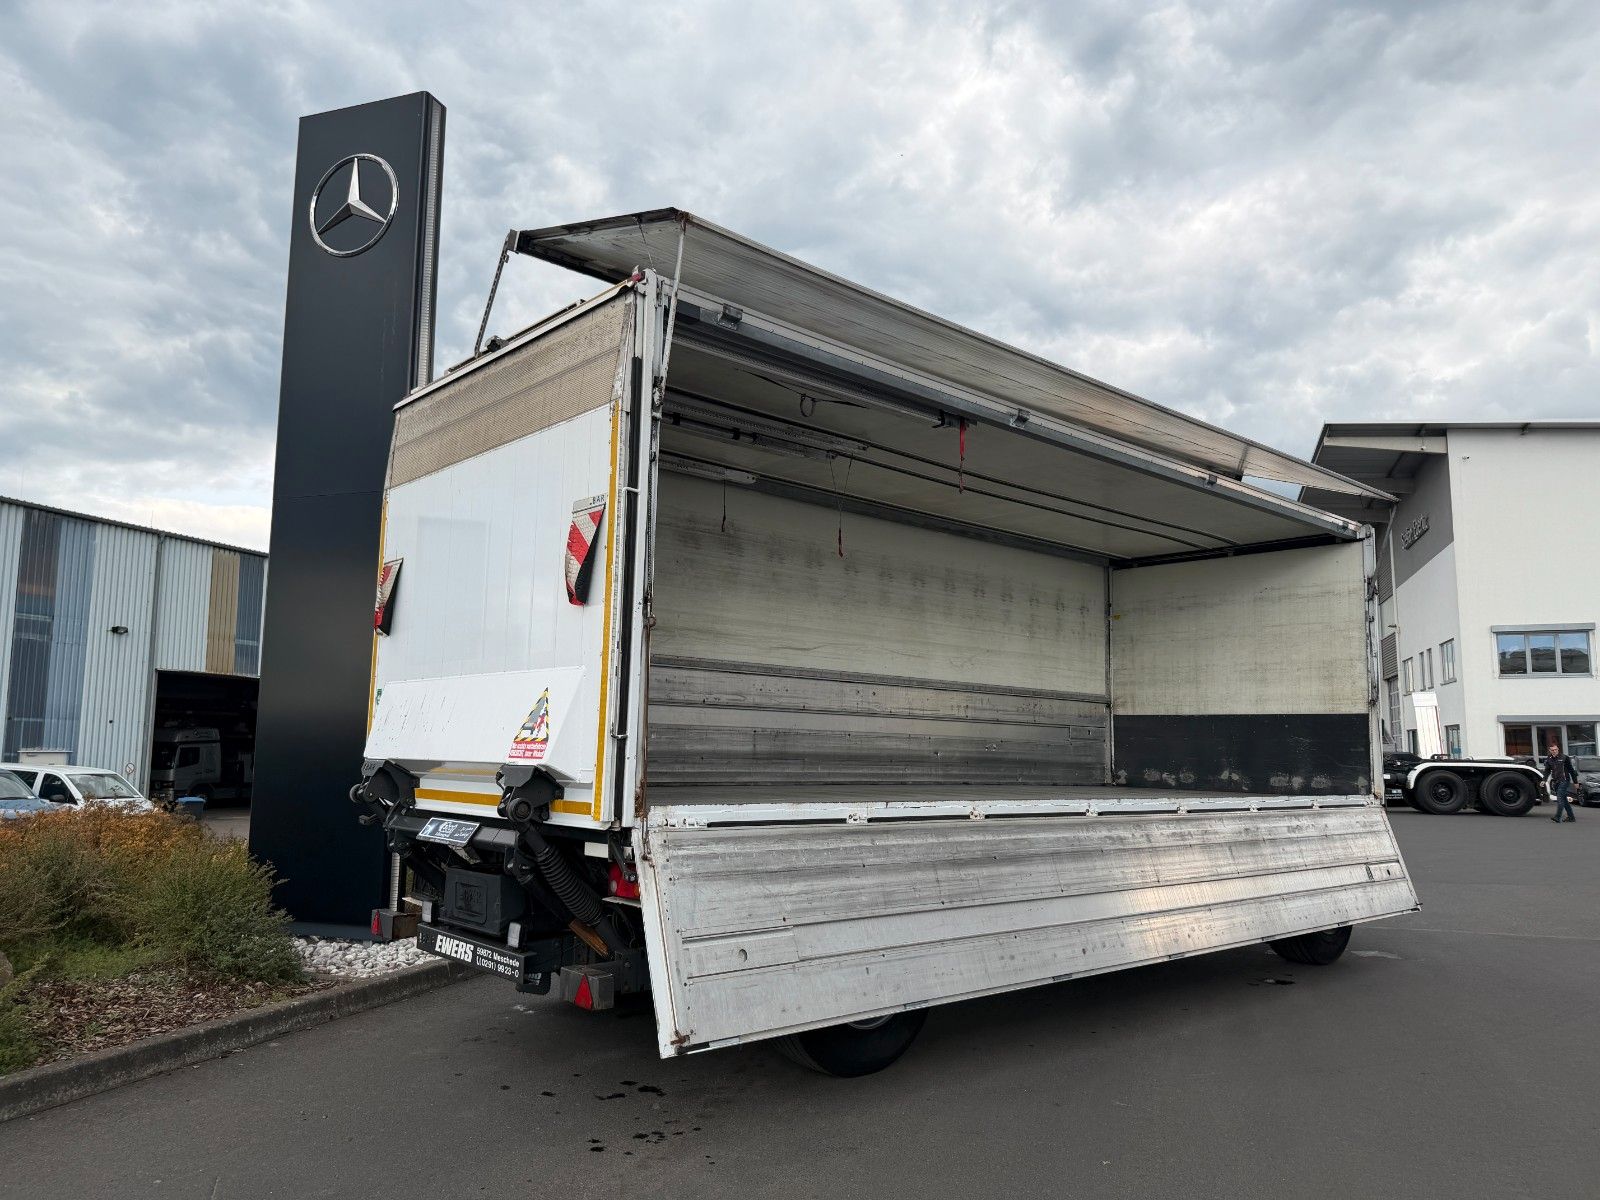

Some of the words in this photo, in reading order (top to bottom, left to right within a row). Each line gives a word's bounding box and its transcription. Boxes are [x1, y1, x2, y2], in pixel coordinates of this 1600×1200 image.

[435, 935, 474, 963] EWERS
[476, 947, 492, 959] 59872
[493, 951, 519, 968] Meschede
